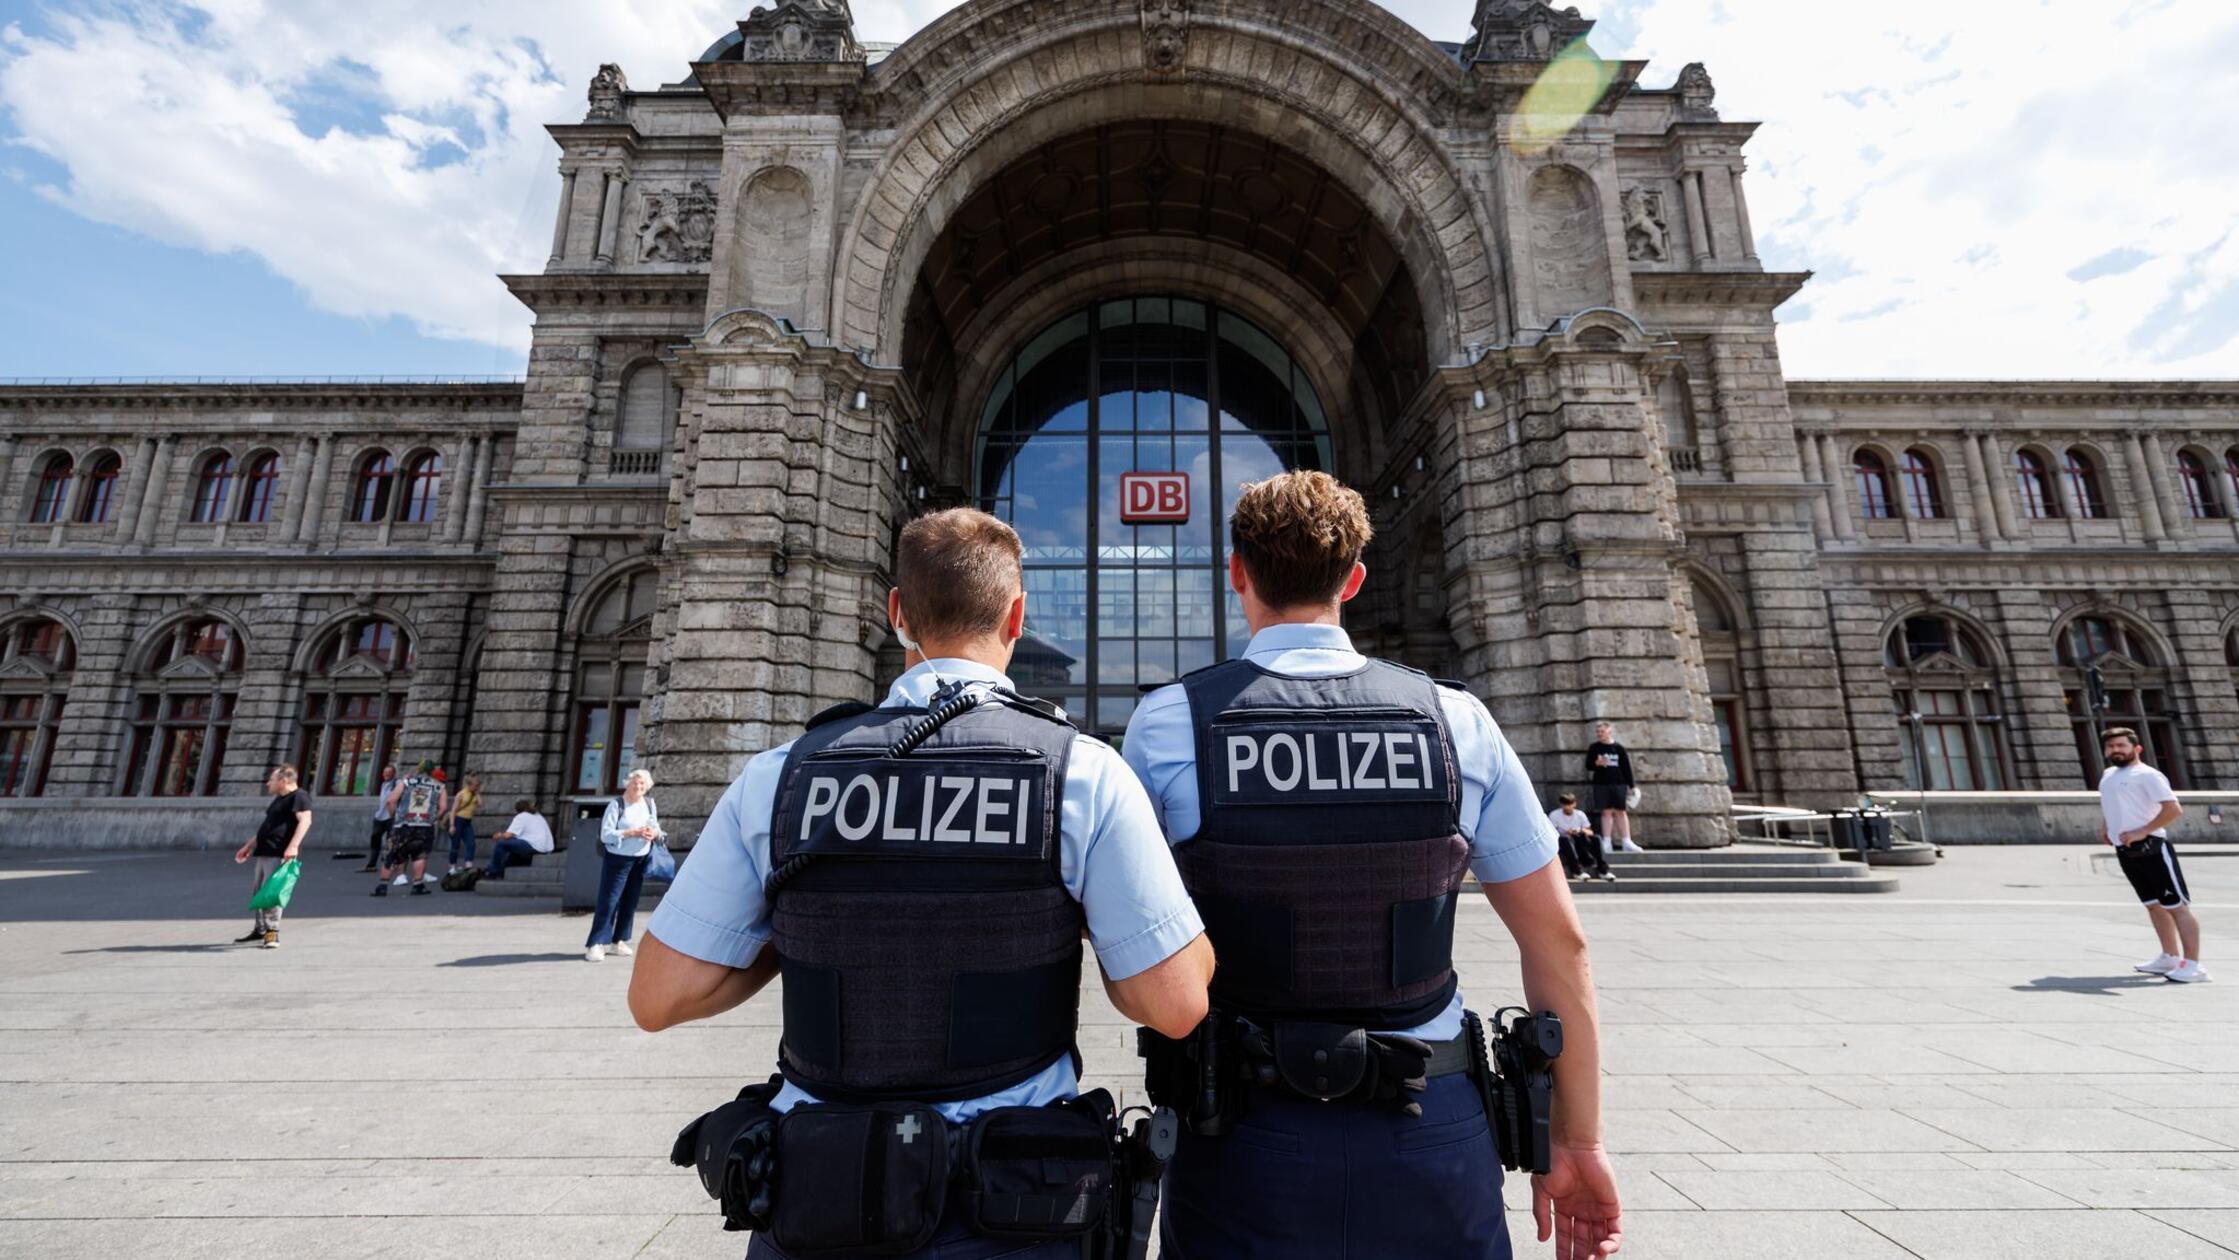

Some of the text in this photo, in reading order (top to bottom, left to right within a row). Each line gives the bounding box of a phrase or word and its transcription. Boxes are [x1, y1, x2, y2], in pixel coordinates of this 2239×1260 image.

[1130, 481, 1183, 512] DB
[1226, 732, 1434, 792] POLIZEI
[800, 773, 1029, 844] POLIZEI
